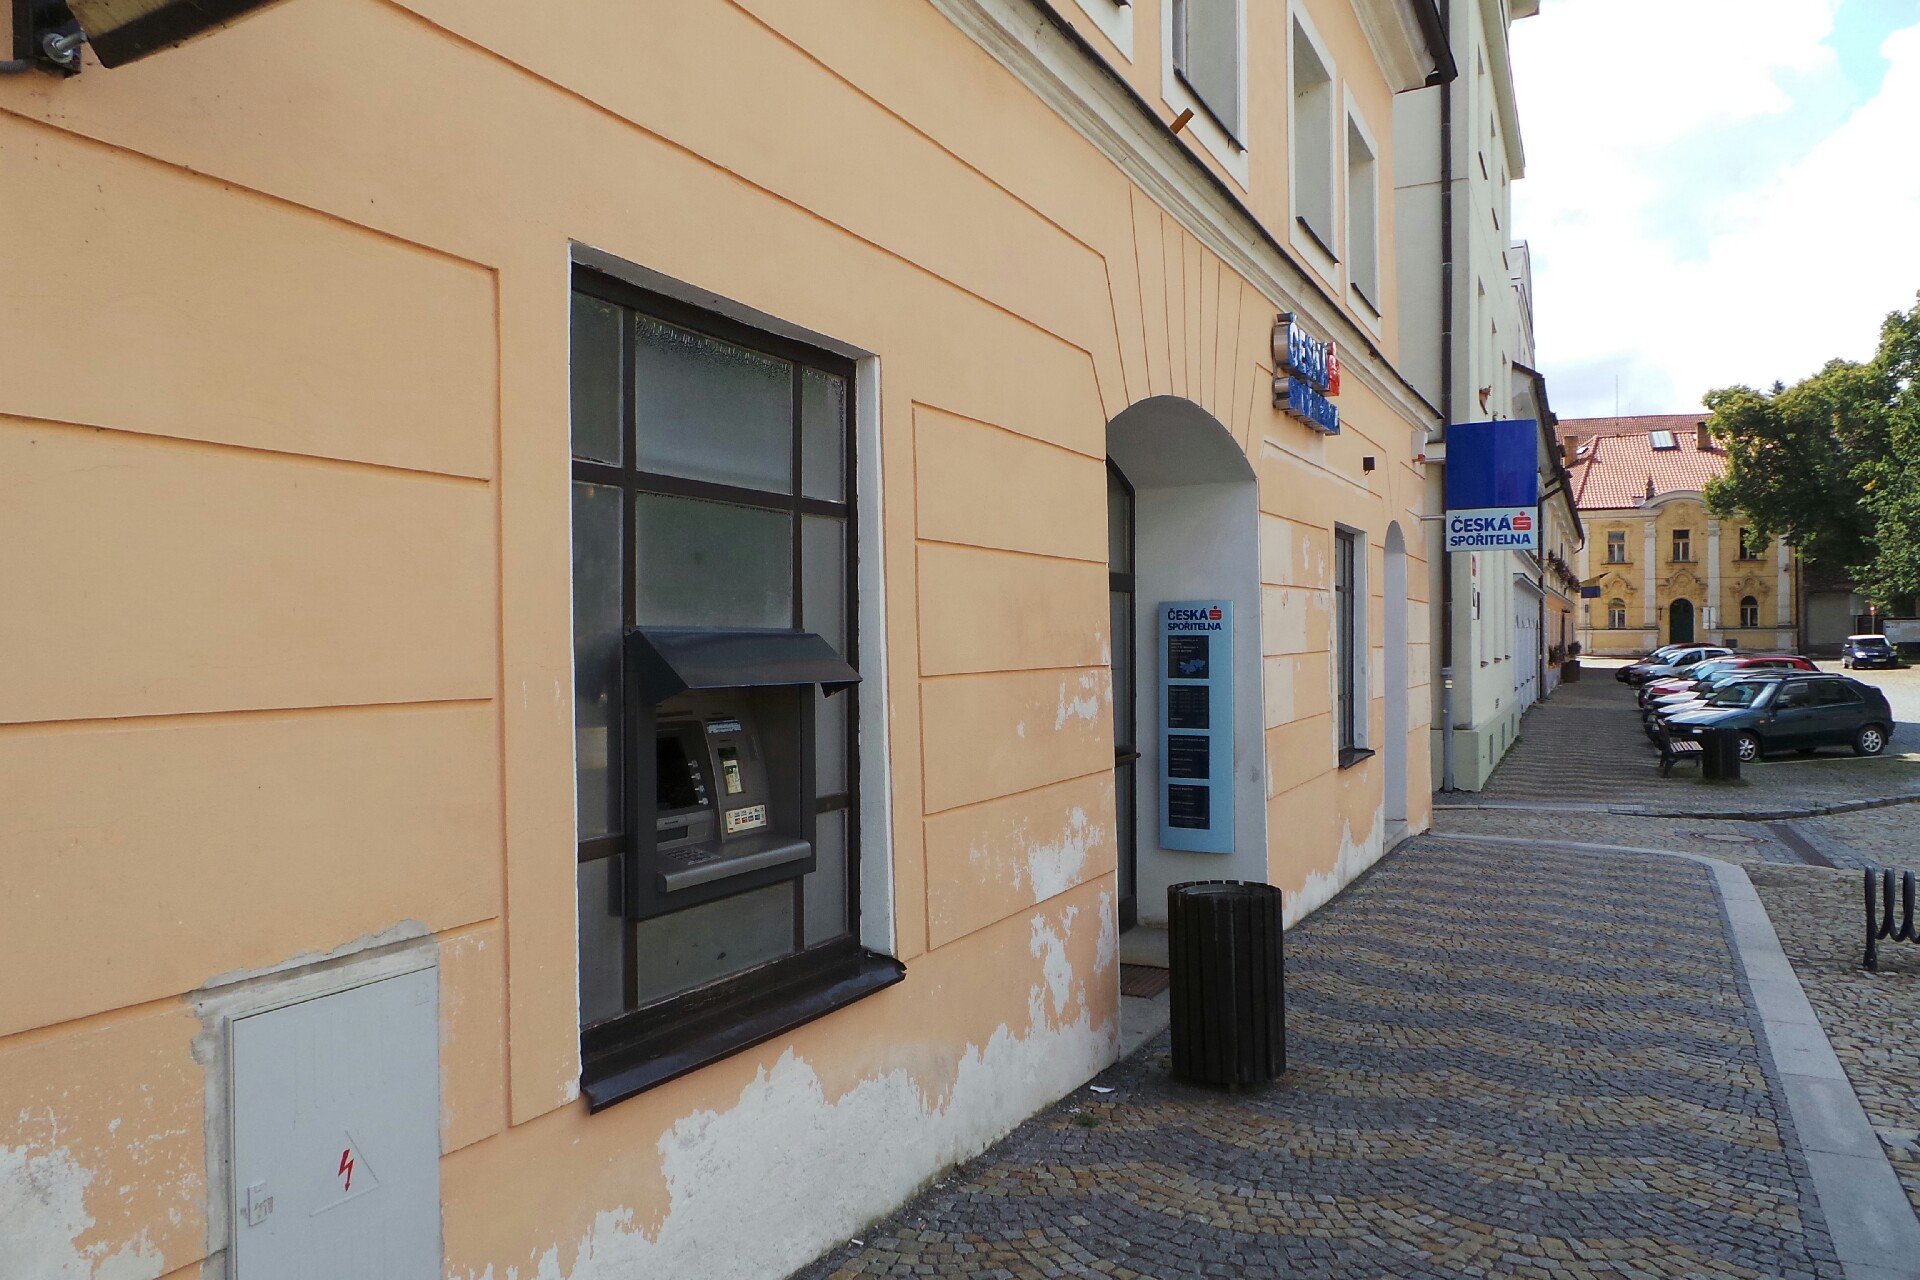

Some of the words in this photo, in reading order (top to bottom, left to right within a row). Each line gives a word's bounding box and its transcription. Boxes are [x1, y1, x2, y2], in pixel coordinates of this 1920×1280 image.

[1451, 514, 1511, 533] ČESKÁ
[1450, 533, 1531, 546] SPOŘITELNA
[1168, 608, 1208, 620] ČESKÁ
[1168, 621, 1221, 630] SPOŘITELNA
